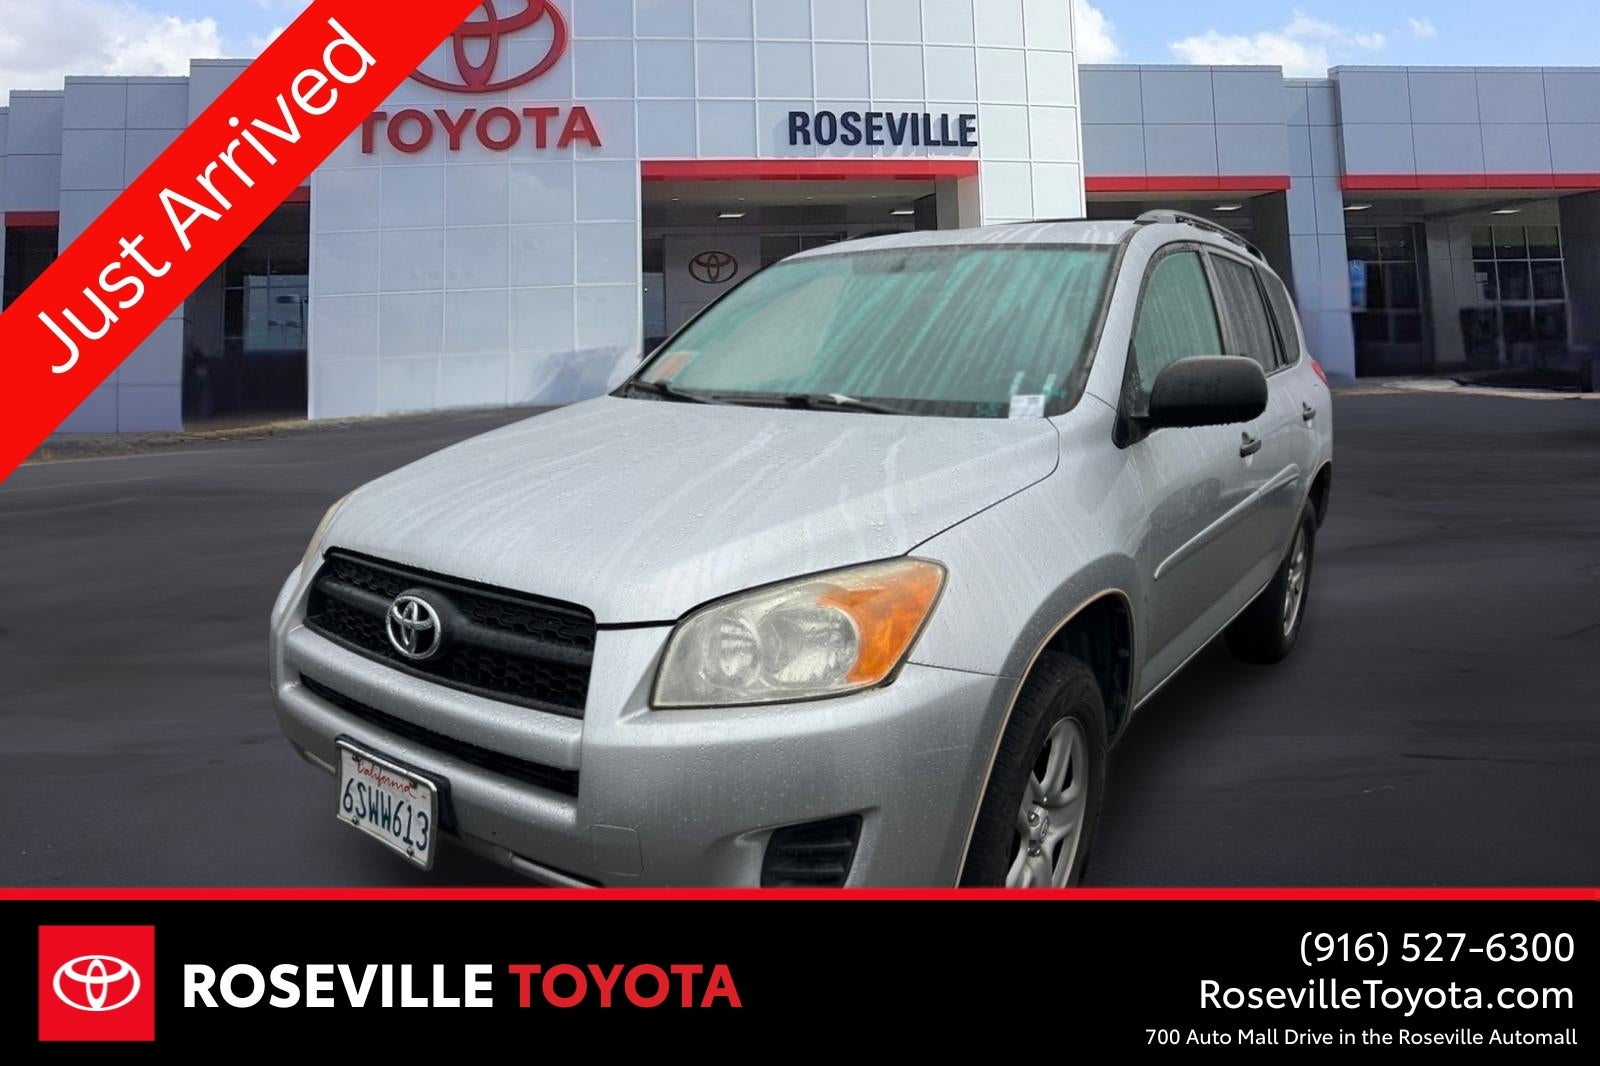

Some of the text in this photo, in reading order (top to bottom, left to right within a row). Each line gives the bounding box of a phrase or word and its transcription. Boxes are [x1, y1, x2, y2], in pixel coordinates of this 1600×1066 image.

[361, 106, 602, 154] TOYOTA
[788, 110, 978, 147] ROSEVILLE
[355, 756, 416, 800] California
[342, 777, 430, 851] 6SWW613
